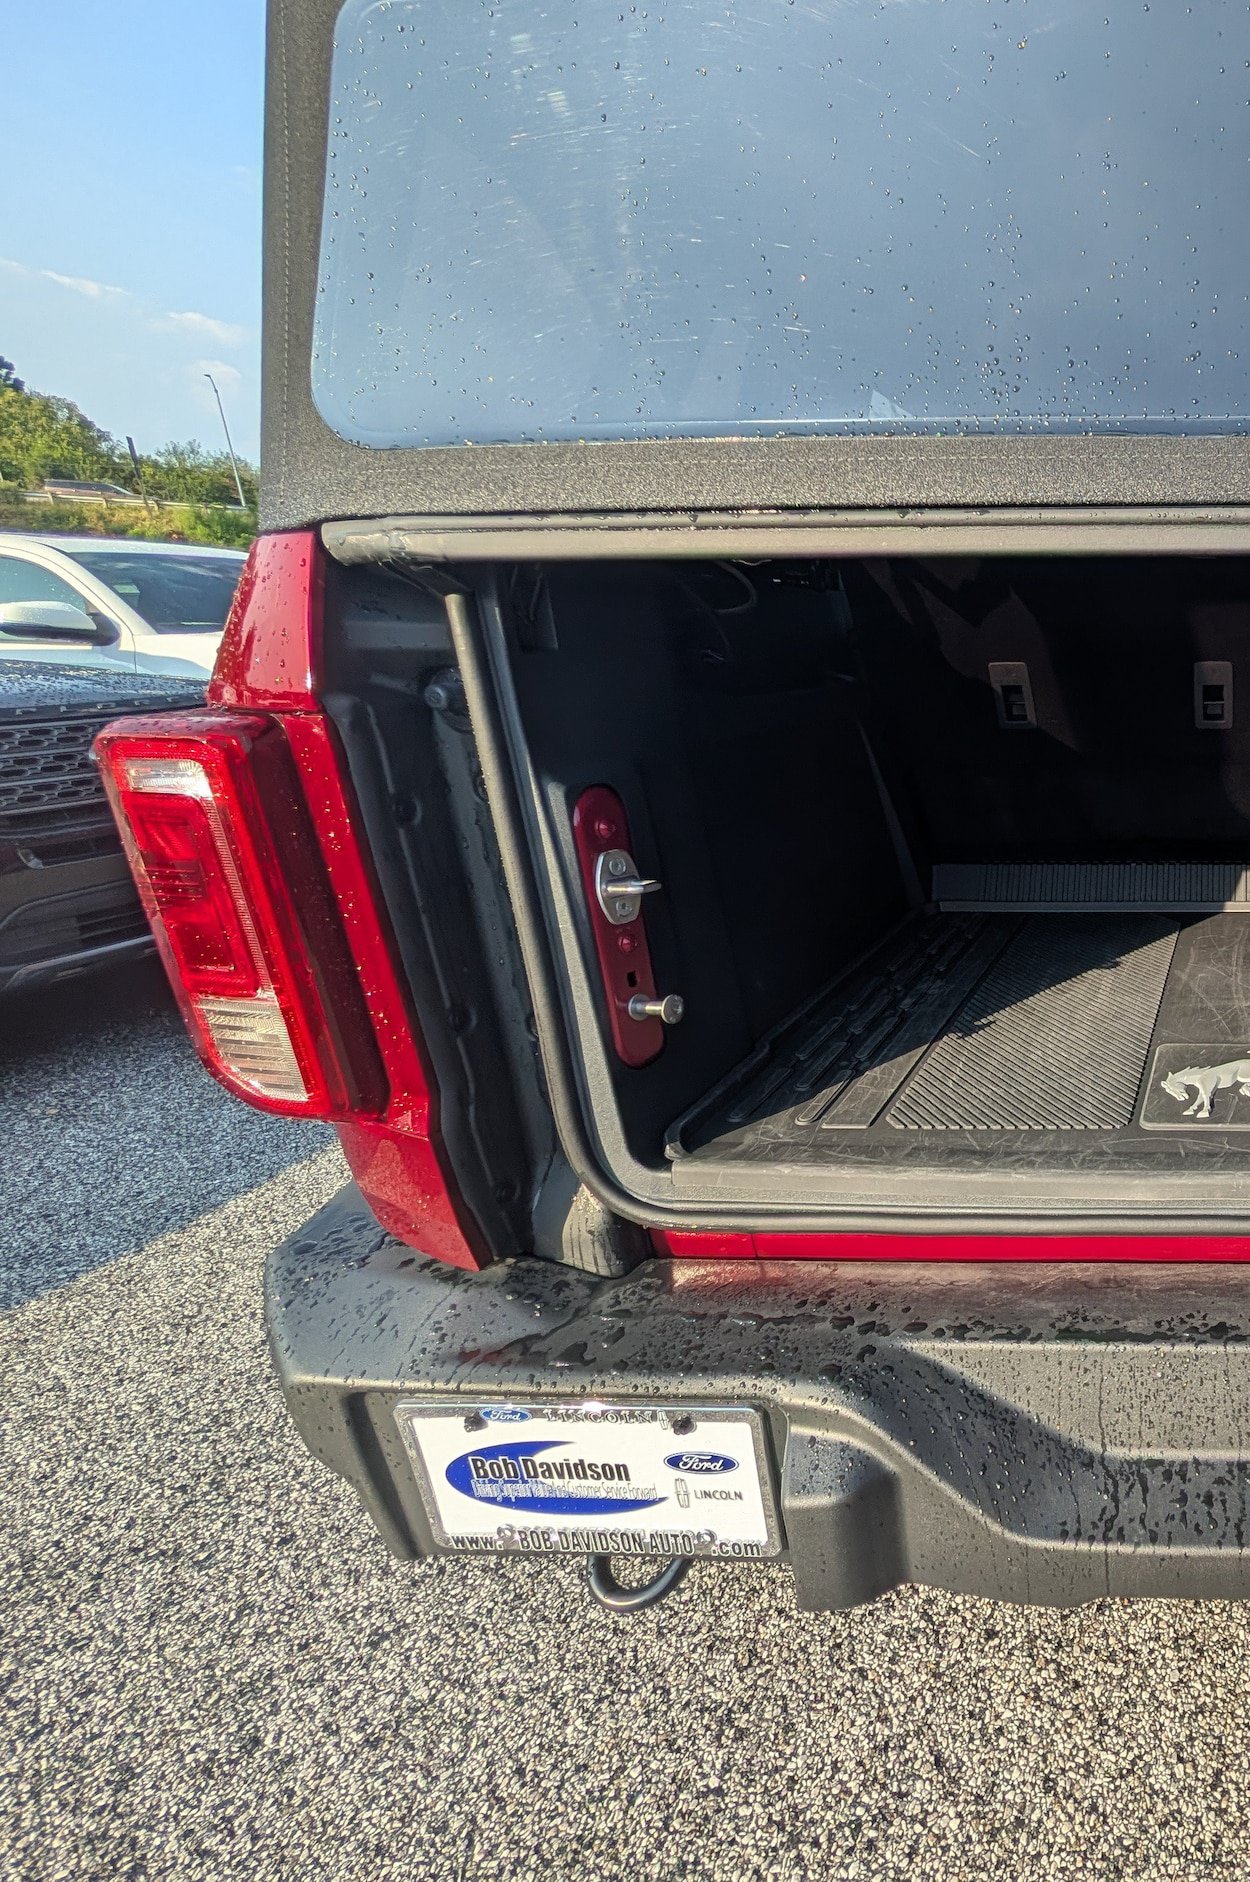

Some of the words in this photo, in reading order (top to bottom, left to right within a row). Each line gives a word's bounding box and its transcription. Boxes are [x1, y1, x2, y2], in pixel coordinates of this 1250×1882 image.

[543, 1408, 653, 1424] LINCOLN
[469, 1456, 520, 1480] Bob
[520, 1456, 631, 1481] Davidson
[679, 1454, 723, 1471] Ford
[601, 1482, 628, 1500] Service
[627, 1483, 658, 1501] Forward
[694, 1490, 743, 1501] LINCOLN
[451, 1535, 504, 1550] www.
[518, 1529, 554, 1551] BOB
[557, 1530, 645, 1553] DAVIDSON
[650, 1532, 695, 1556] AUTO
[711, 1541, 762, 1557] .com
